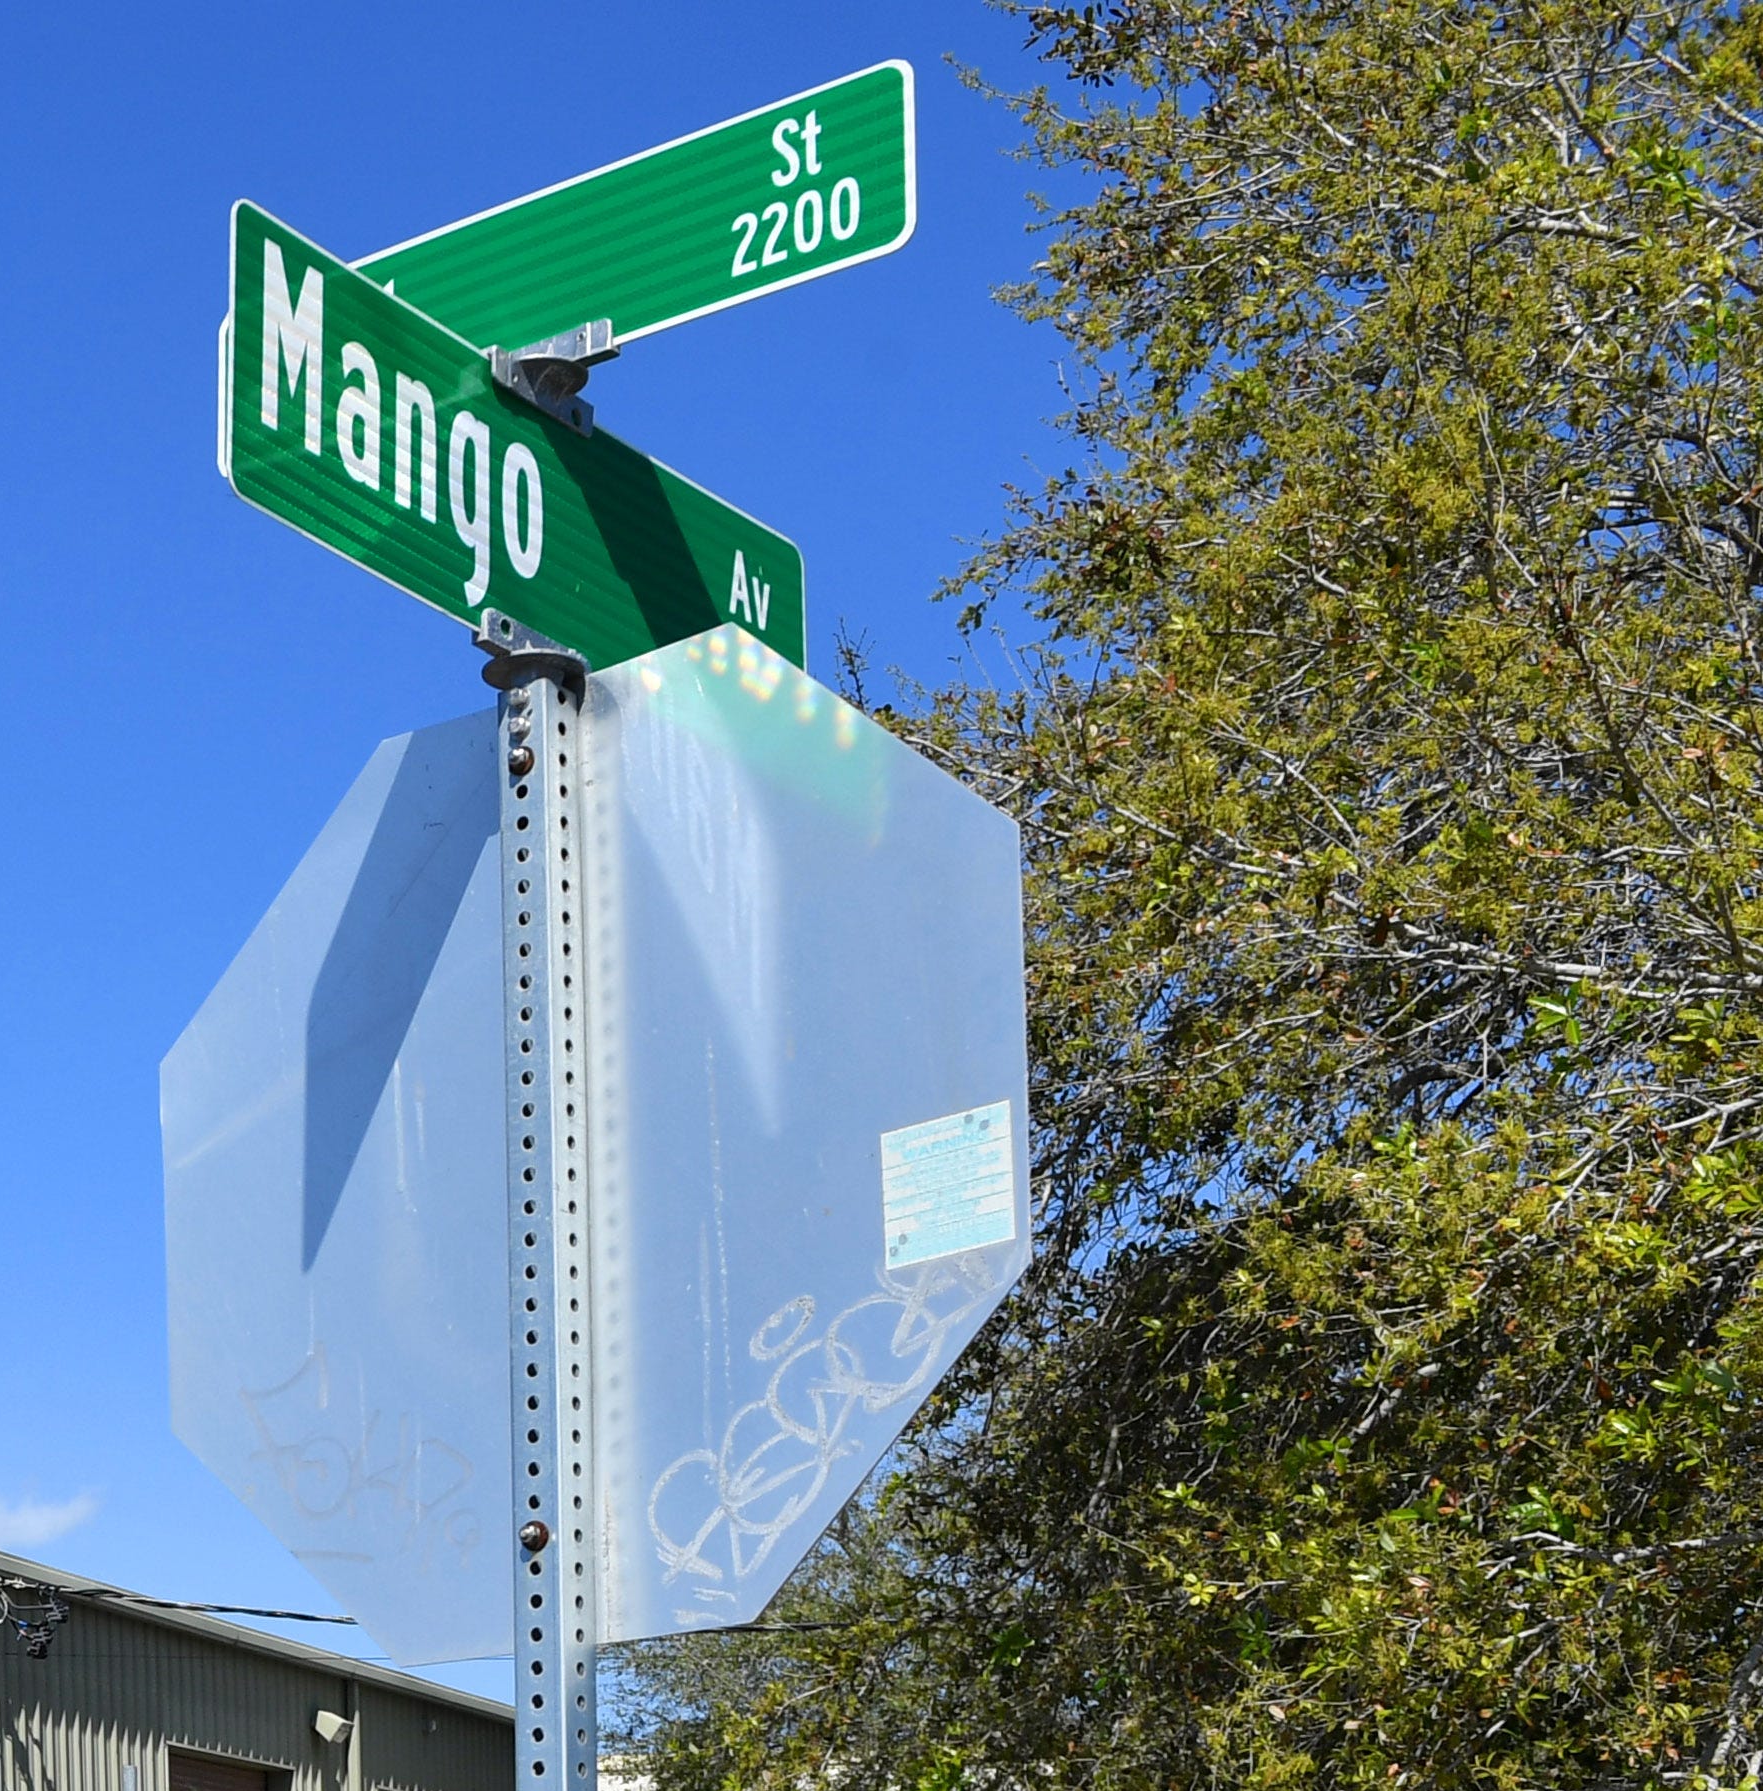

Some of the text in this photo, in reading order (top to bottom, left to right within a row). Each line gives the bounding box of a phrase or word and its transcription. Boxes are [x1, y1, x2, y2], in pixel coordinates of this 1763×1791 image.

[770, 109, 822, 187] St
[730, 177, 861, 278] 2200
[261, 238, 770, 631] Mango Av
